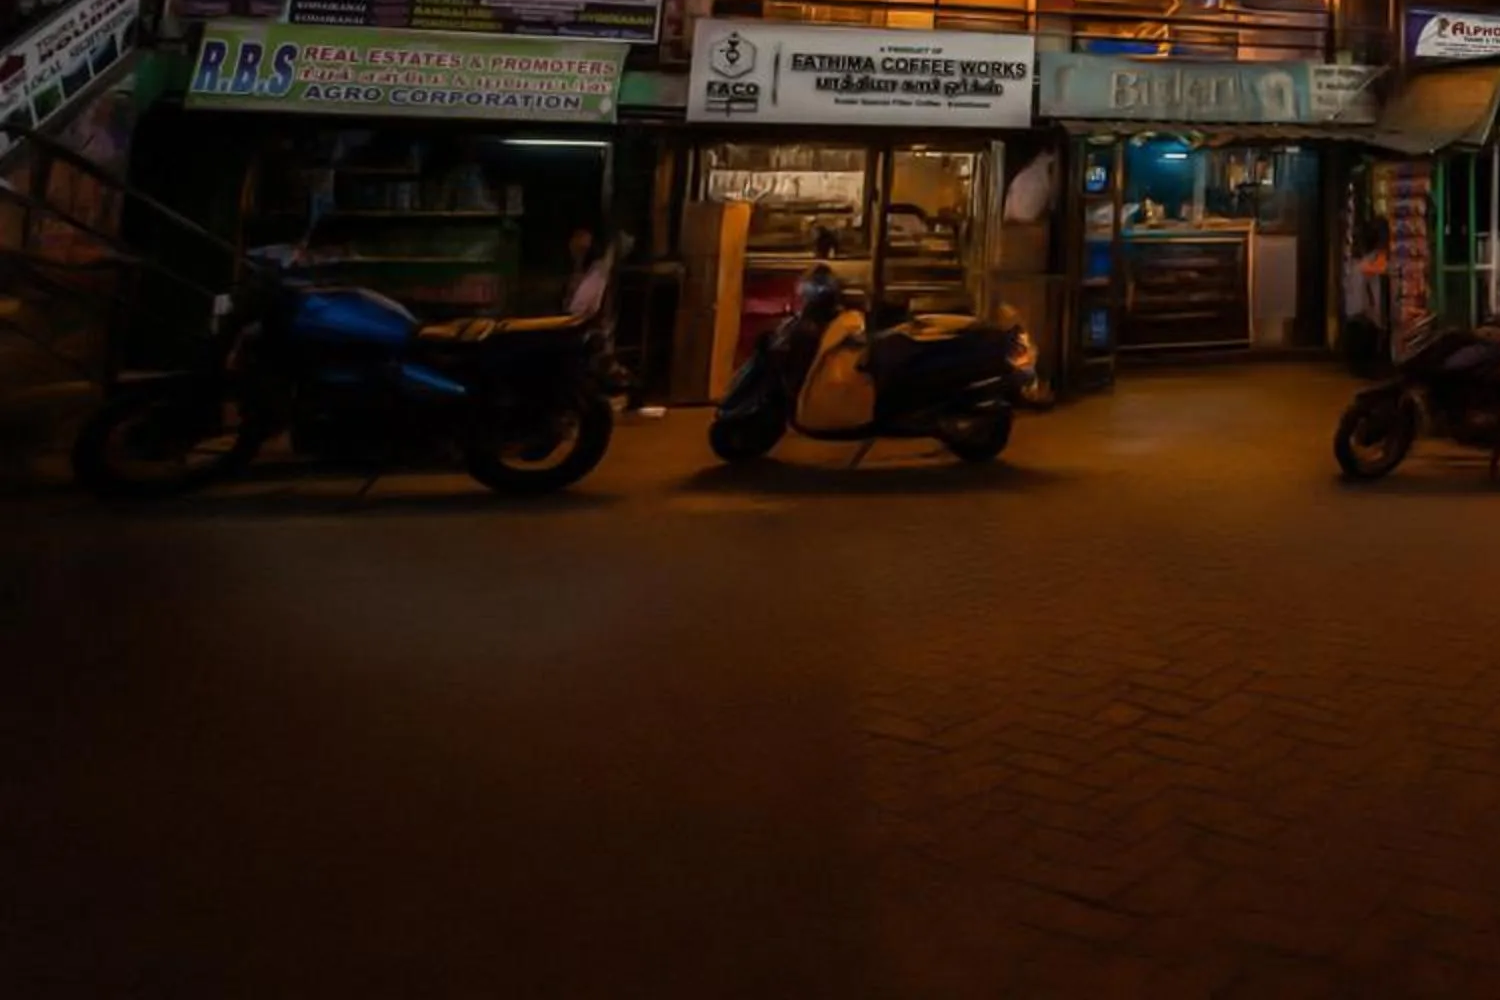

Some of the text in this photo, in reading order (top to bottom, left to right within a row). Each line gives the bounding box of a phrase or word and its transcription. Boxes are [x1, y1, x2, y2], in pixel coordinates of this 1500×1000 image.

[303, 46, 361, 63] REAL
[368, 50, 461, 68] ESTATES
[491, 54, 616, 75] PROMOTERS
[881, 56, 956, 76] COFFEE
[960, 60, 1027, 79] WORKS
[304, 84, 582, 110] AGRO CORPORATION
